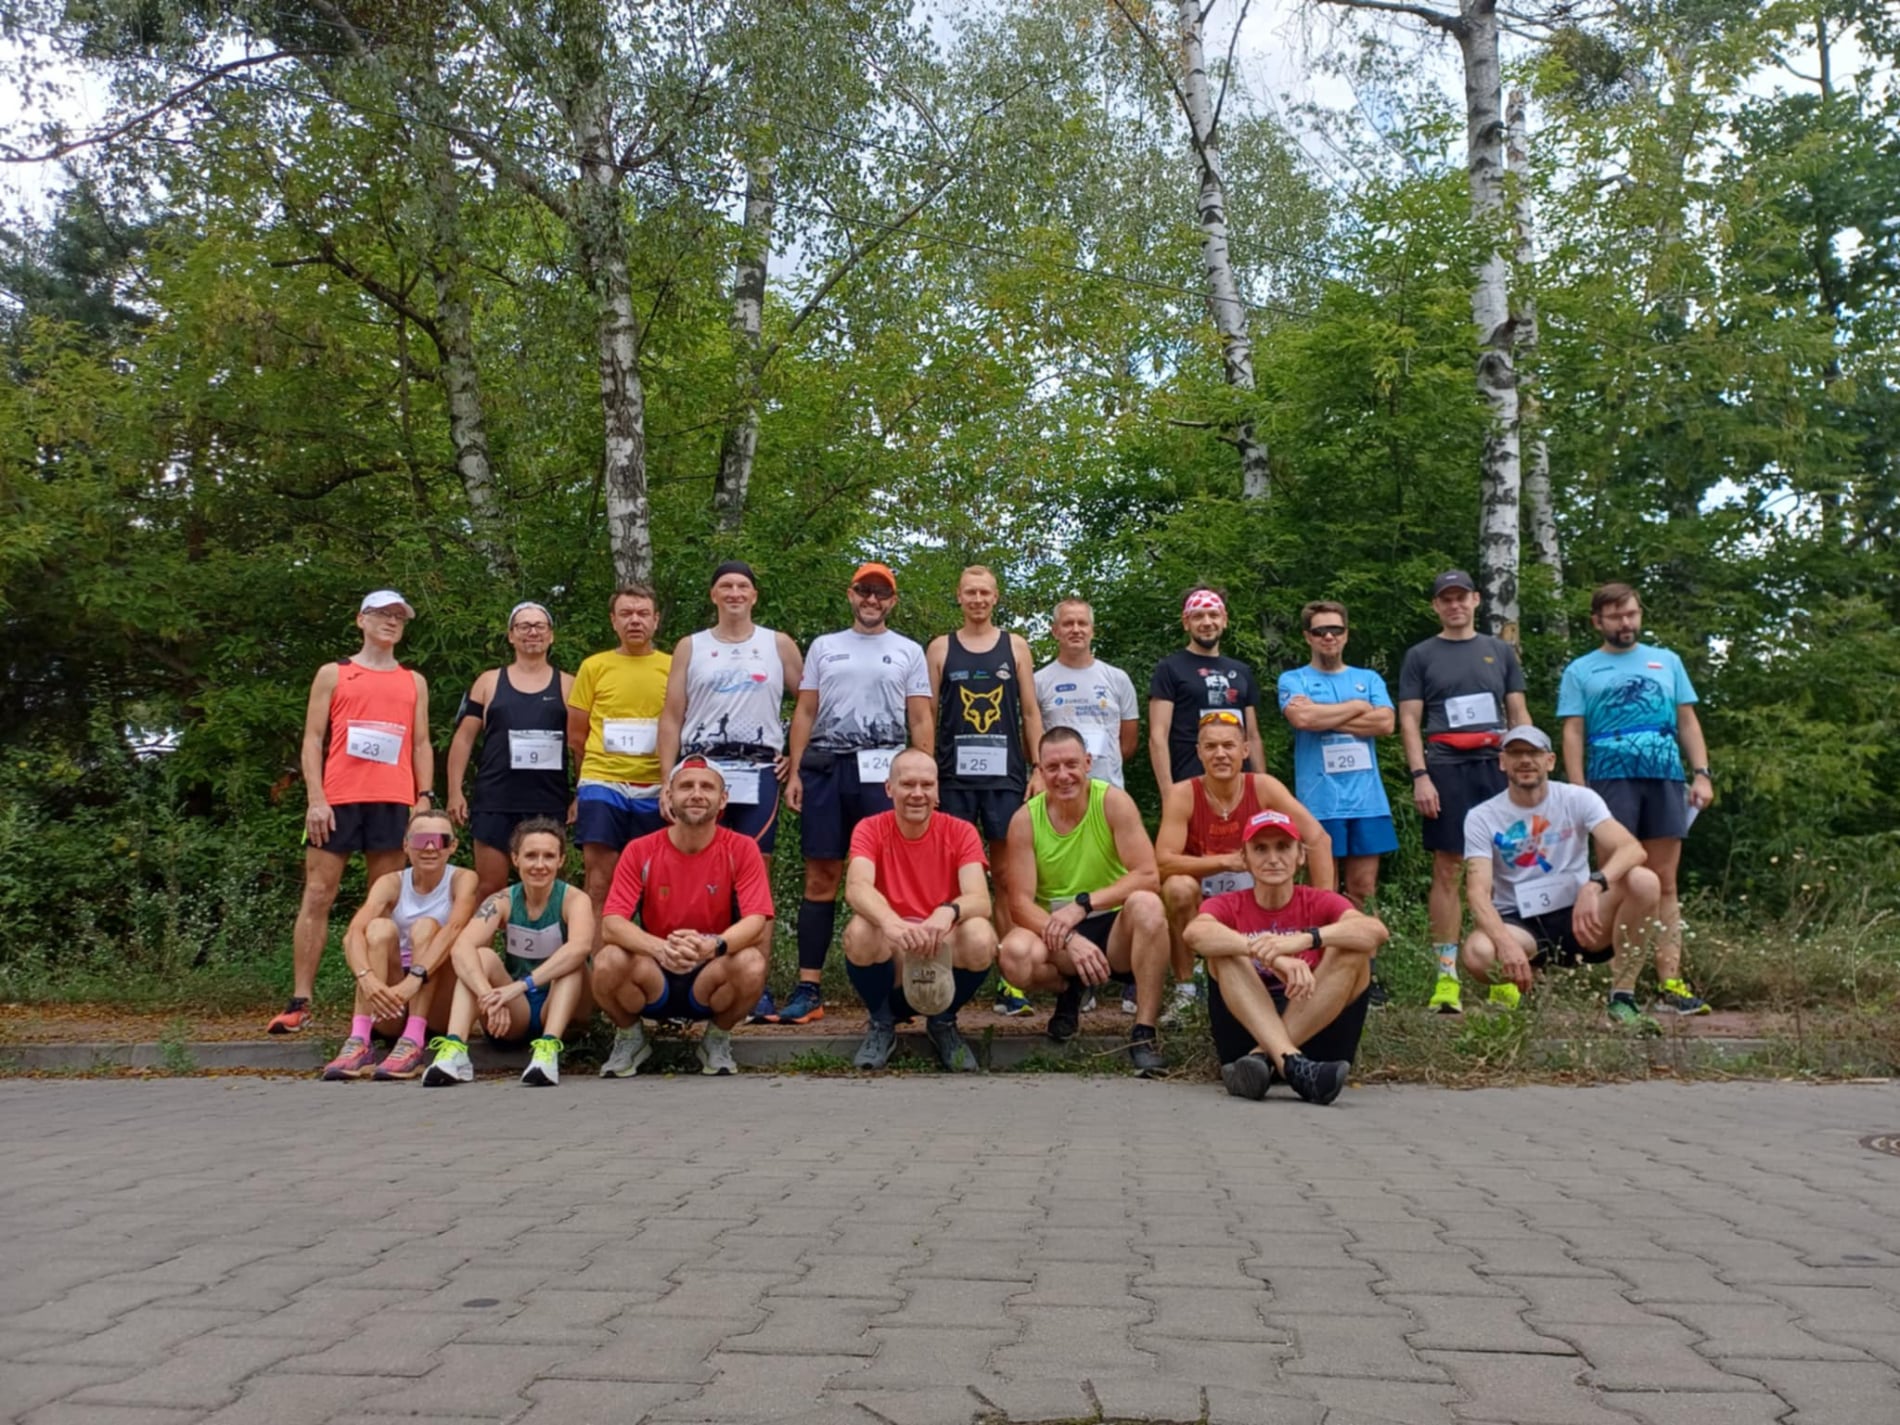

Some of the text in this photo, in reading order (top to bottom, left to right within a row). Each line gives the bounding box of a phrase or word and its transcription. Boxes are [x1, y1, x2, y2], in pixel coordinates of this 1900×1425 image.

[1466, 707, 1476, 719] 5
[620, 735, 635, 746] 11
[361, 741, 380, 757] 23
[529, 751, 538, 763] 9
[873, 756, 889, 769] 24
[1338, 755, 1355, 768] 29
[970, 758, 987, 771] 25
[1217, 879, 1236, 891] 12
[1540, 893, 1551, 907] 3
[524, 938, 534, 952] 2
